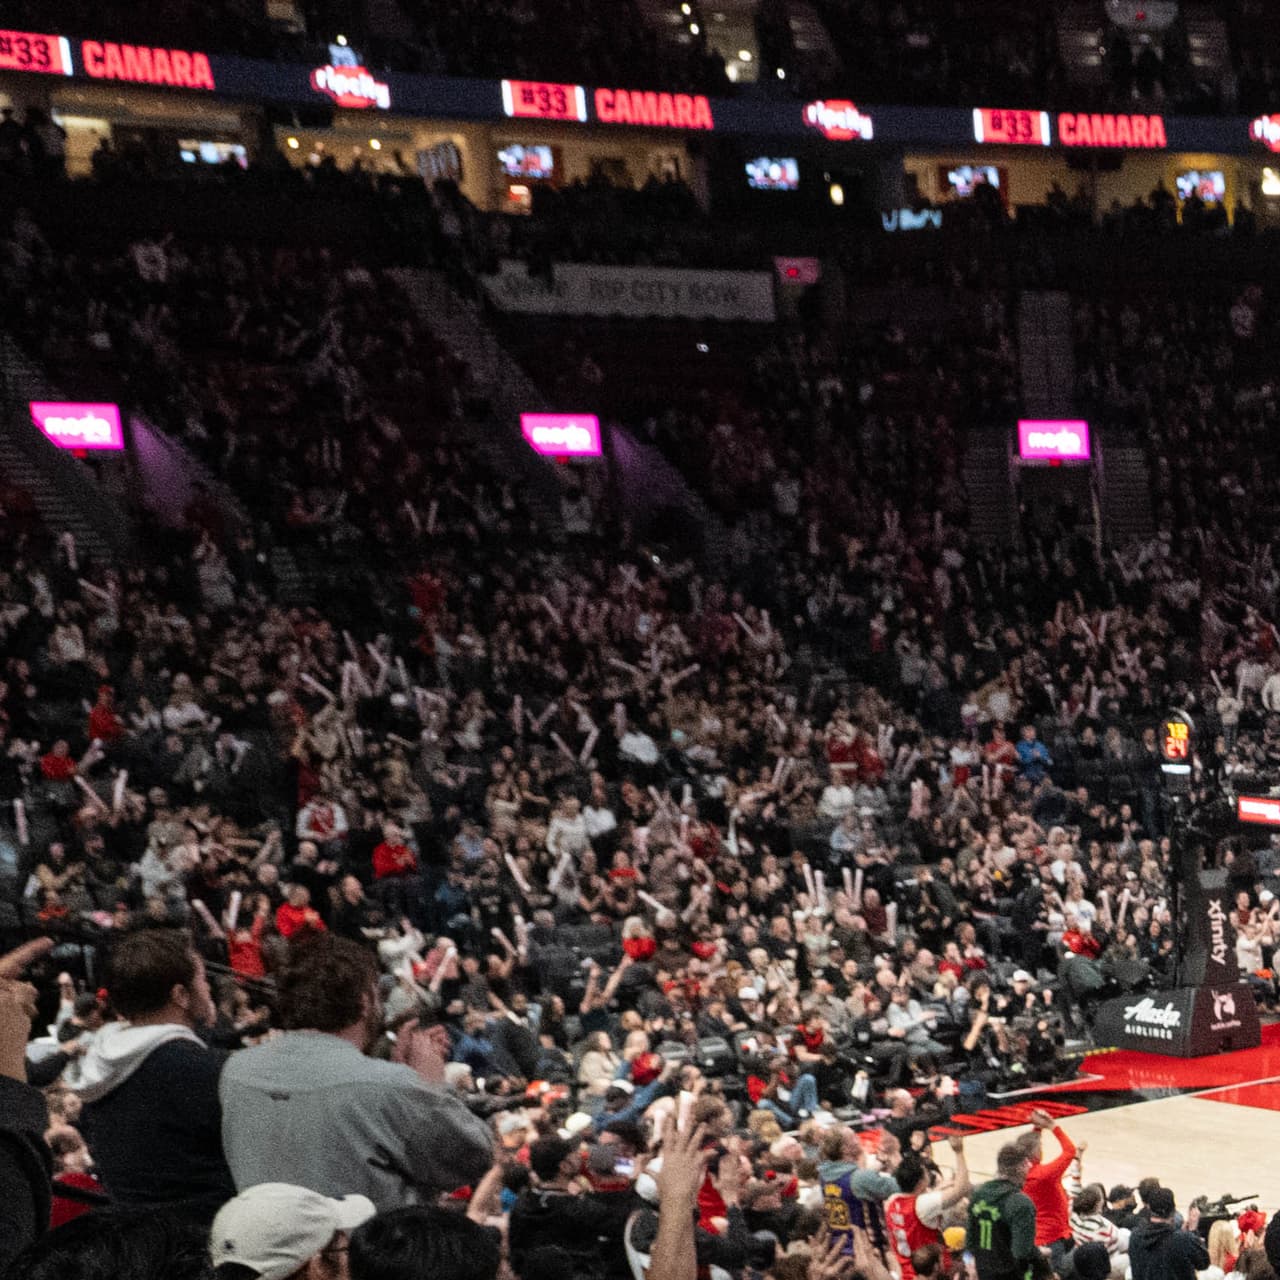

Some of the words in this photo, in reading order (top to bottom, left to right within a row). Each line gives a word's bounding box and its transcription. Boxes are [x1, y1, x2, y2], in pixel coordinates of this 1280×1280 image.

[81, 40, 216, 91] CAMARA
[594, 88, 714, 130] CAMARA
[1058, 113, 1167, 148] CAMARA
[1165, 736, 1188, 759] 24
[1124, 1024, 1173, 1040] AIRLINES
